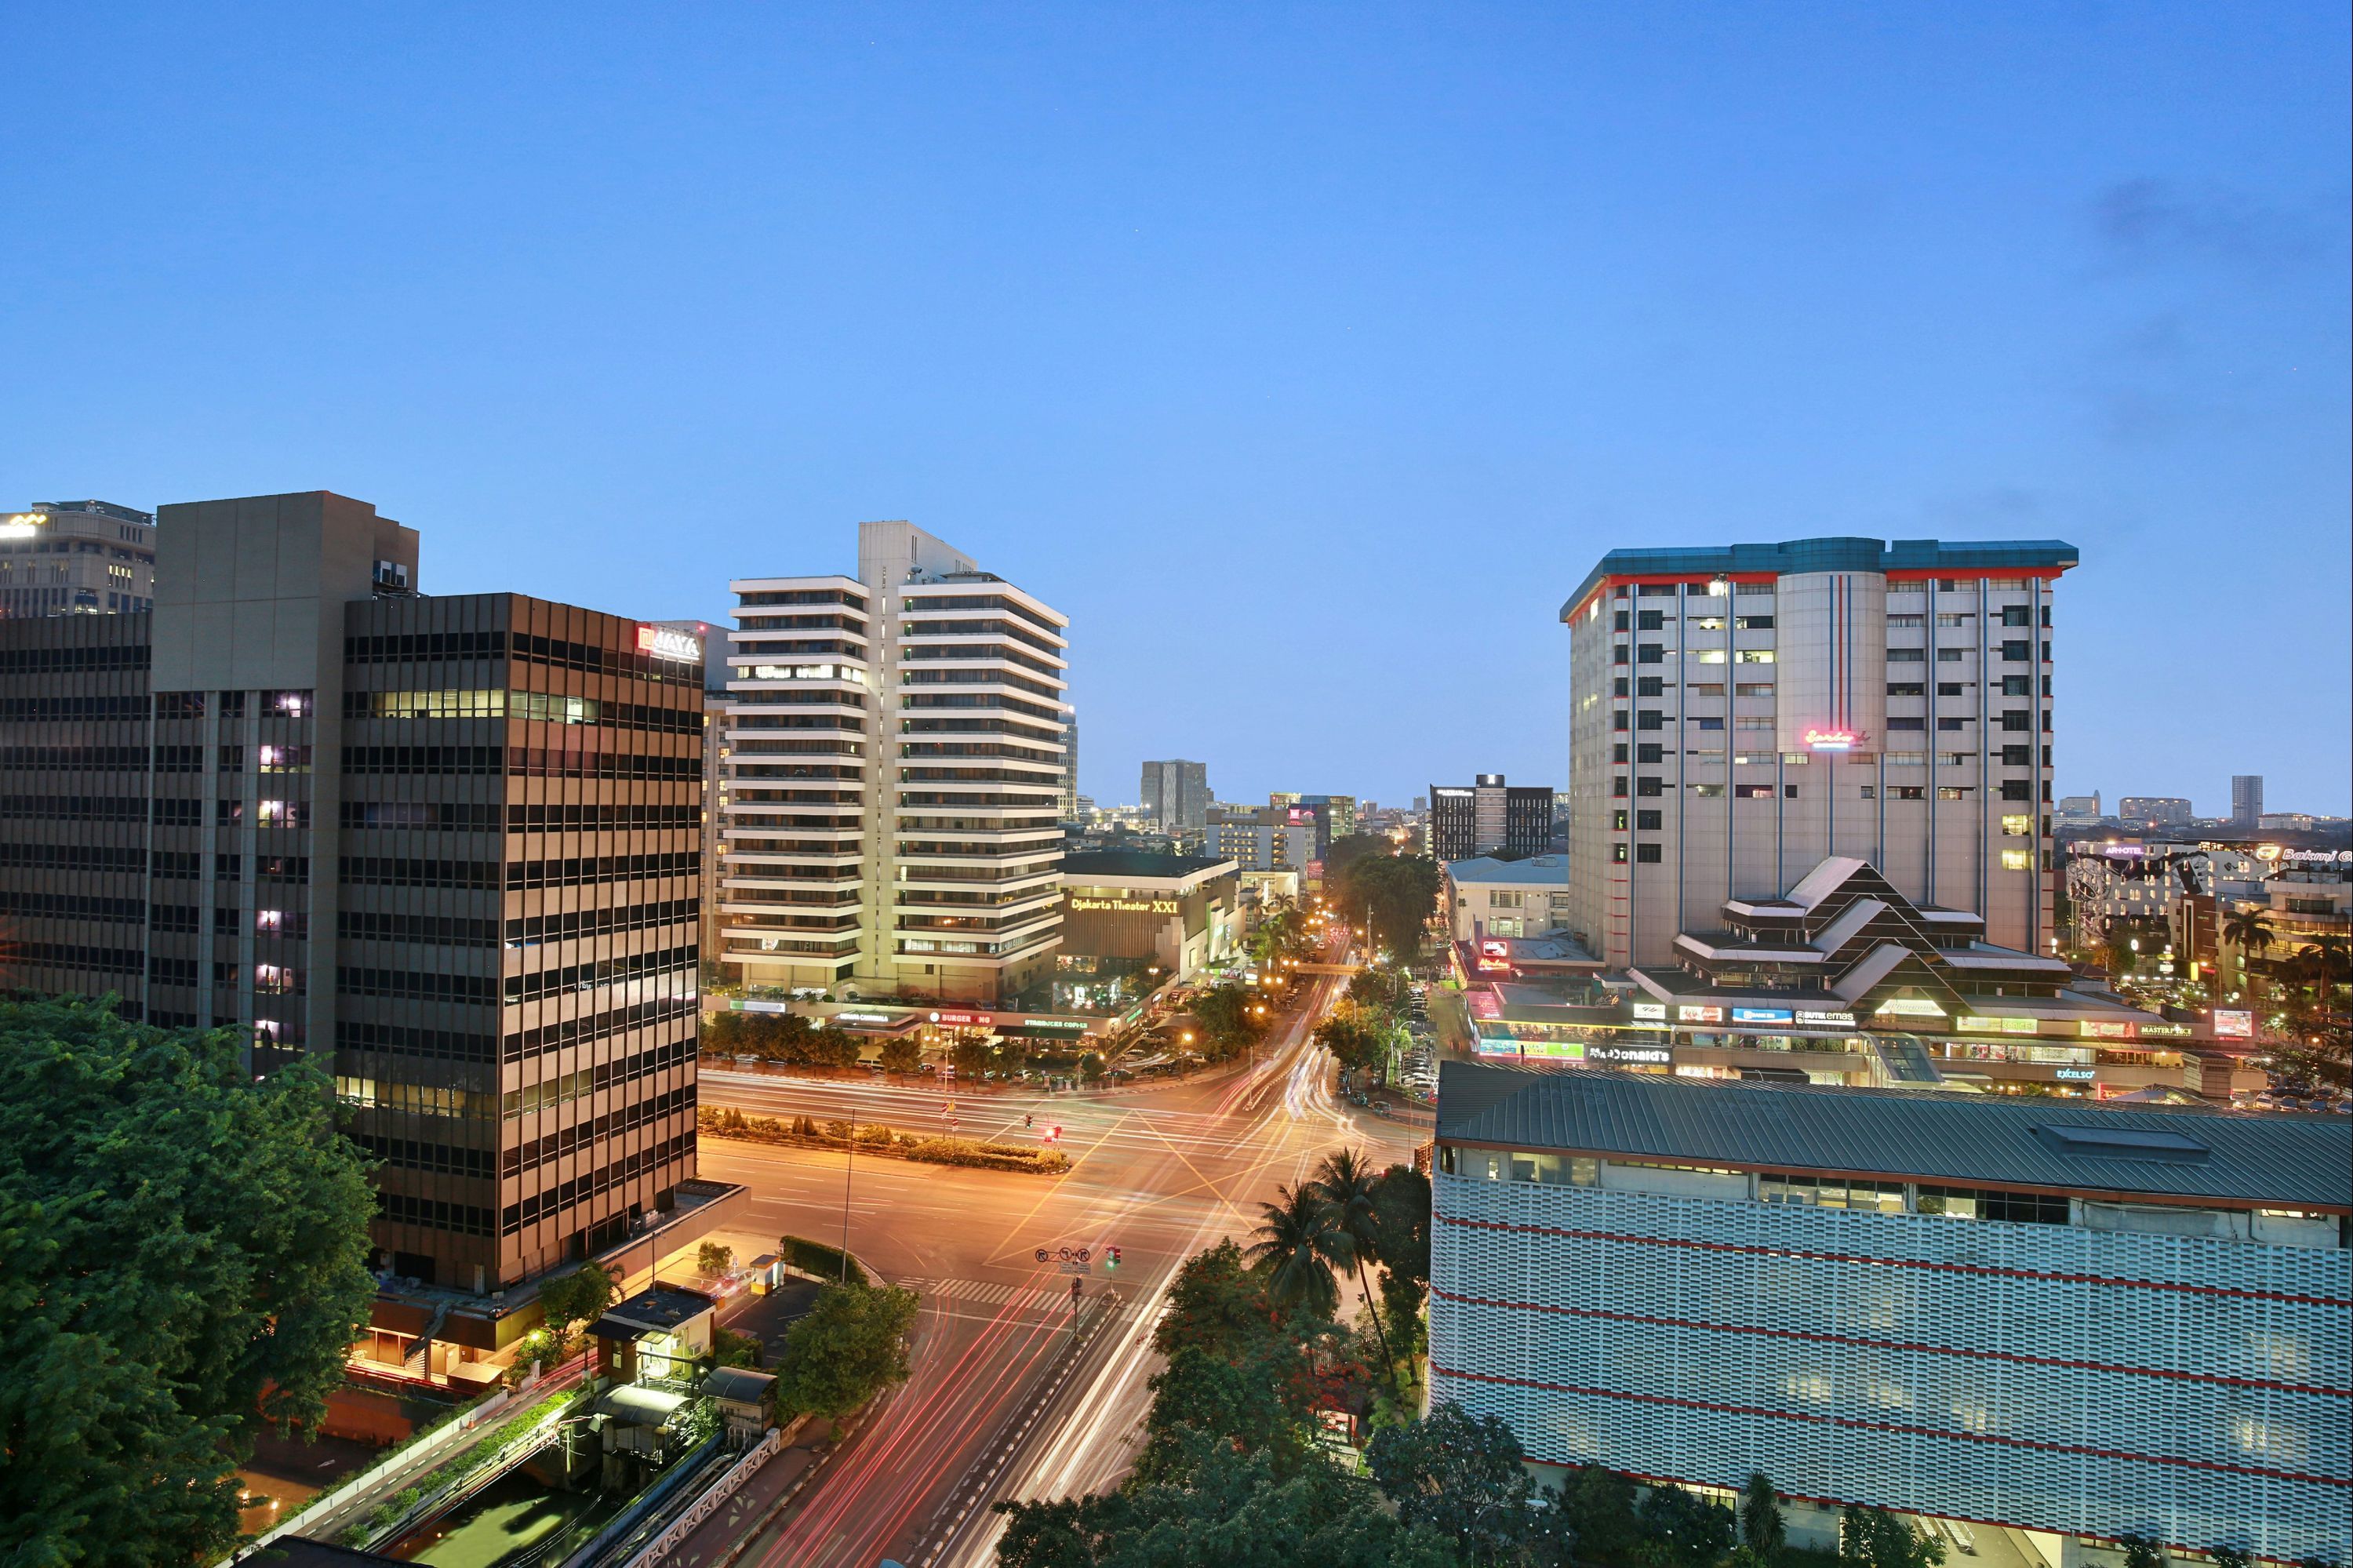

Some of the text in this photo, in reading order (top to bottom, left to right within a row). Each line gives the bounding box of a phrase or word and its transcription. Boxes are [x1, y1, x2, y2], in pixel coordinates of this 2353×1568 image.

[2282, 849, 2352, 862] Bakmi G
[1071, 899, 1178, 913] Djakarta Theater XXI
[942, 1014, 971, 1023] BURGER
[1590, 1047, 1669, 1061] MDonald's
[2057, 1068, 2093, 1079] EXCELSO
